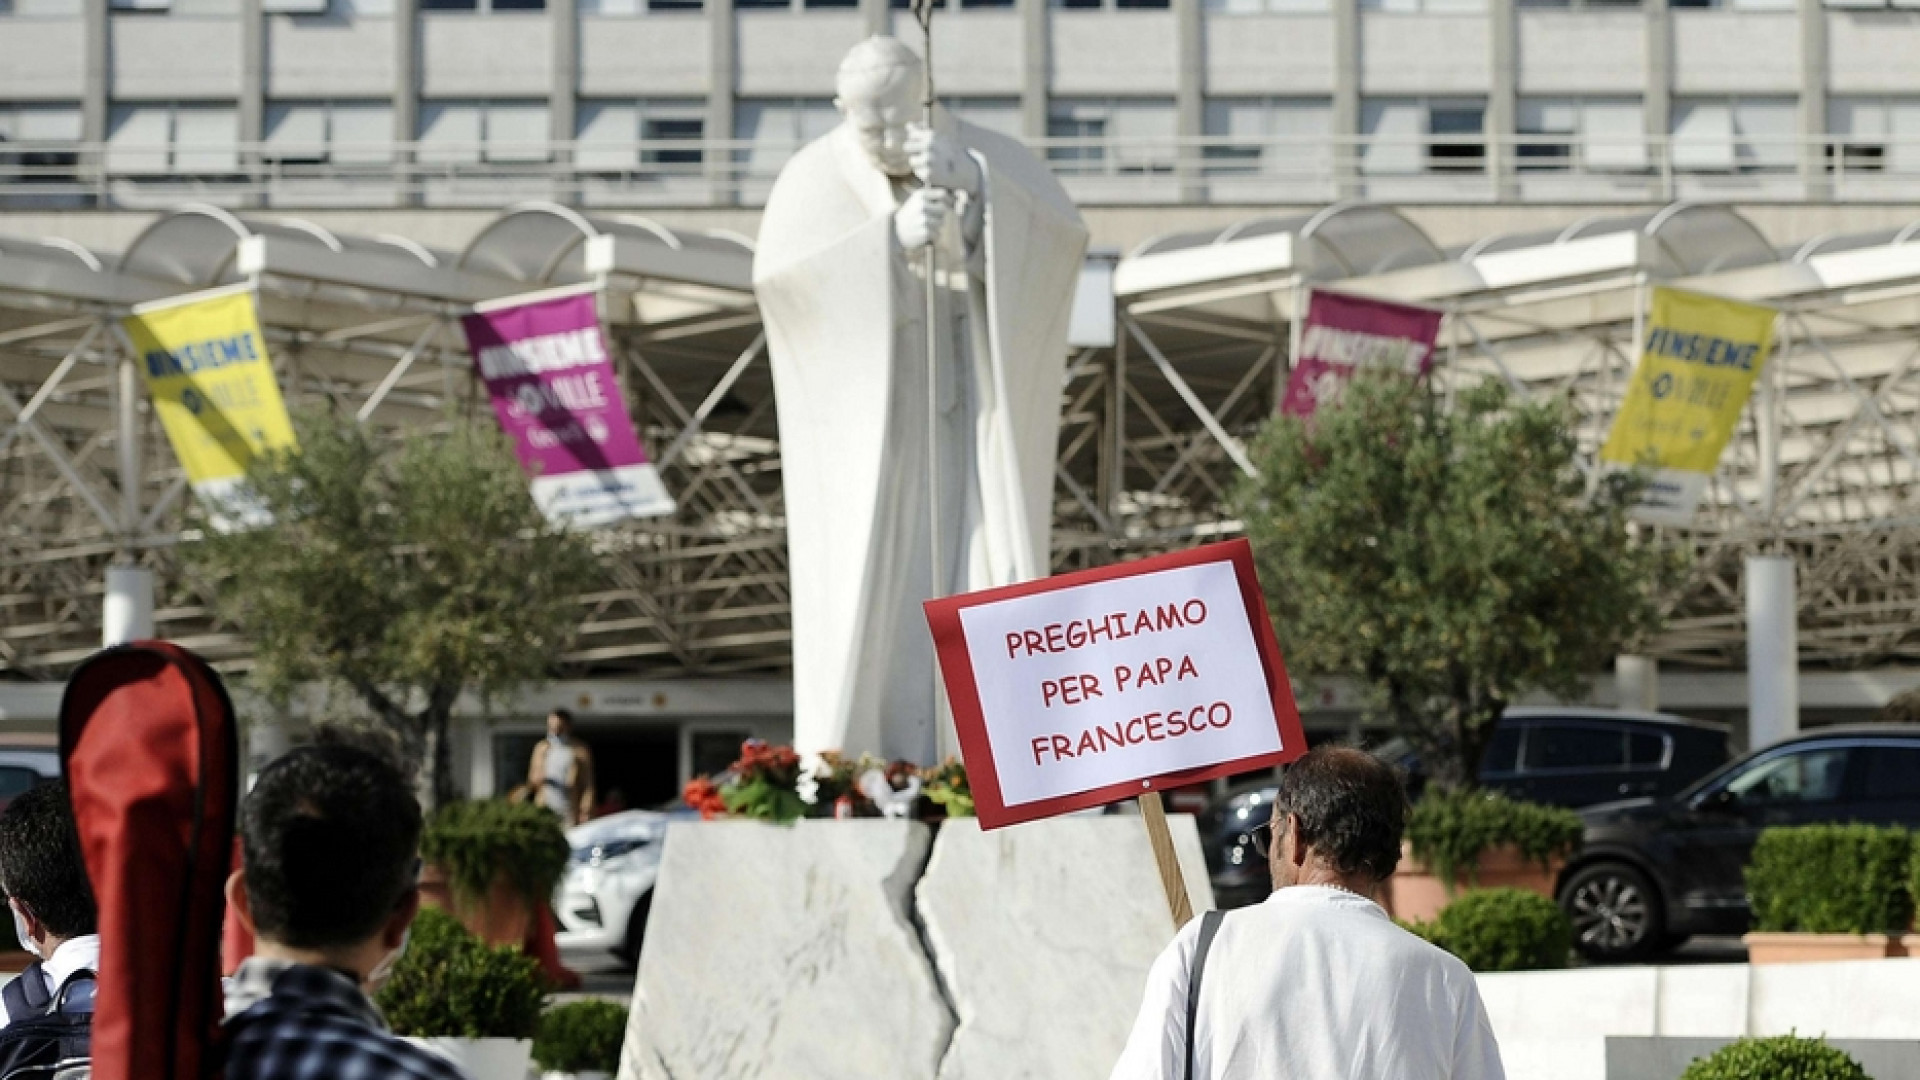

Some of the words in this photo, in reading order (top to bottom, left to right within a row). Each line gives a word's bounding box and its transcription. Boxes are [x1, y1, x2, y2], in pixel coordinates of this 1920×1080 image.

[1005, 598, 1208, 659] PREGHIAMO
[1041, 673, 1103, 708] PER
[1114, 655, 1199, 692] PAPA
[1031, 700, 1233, 766] FRANCESCO
